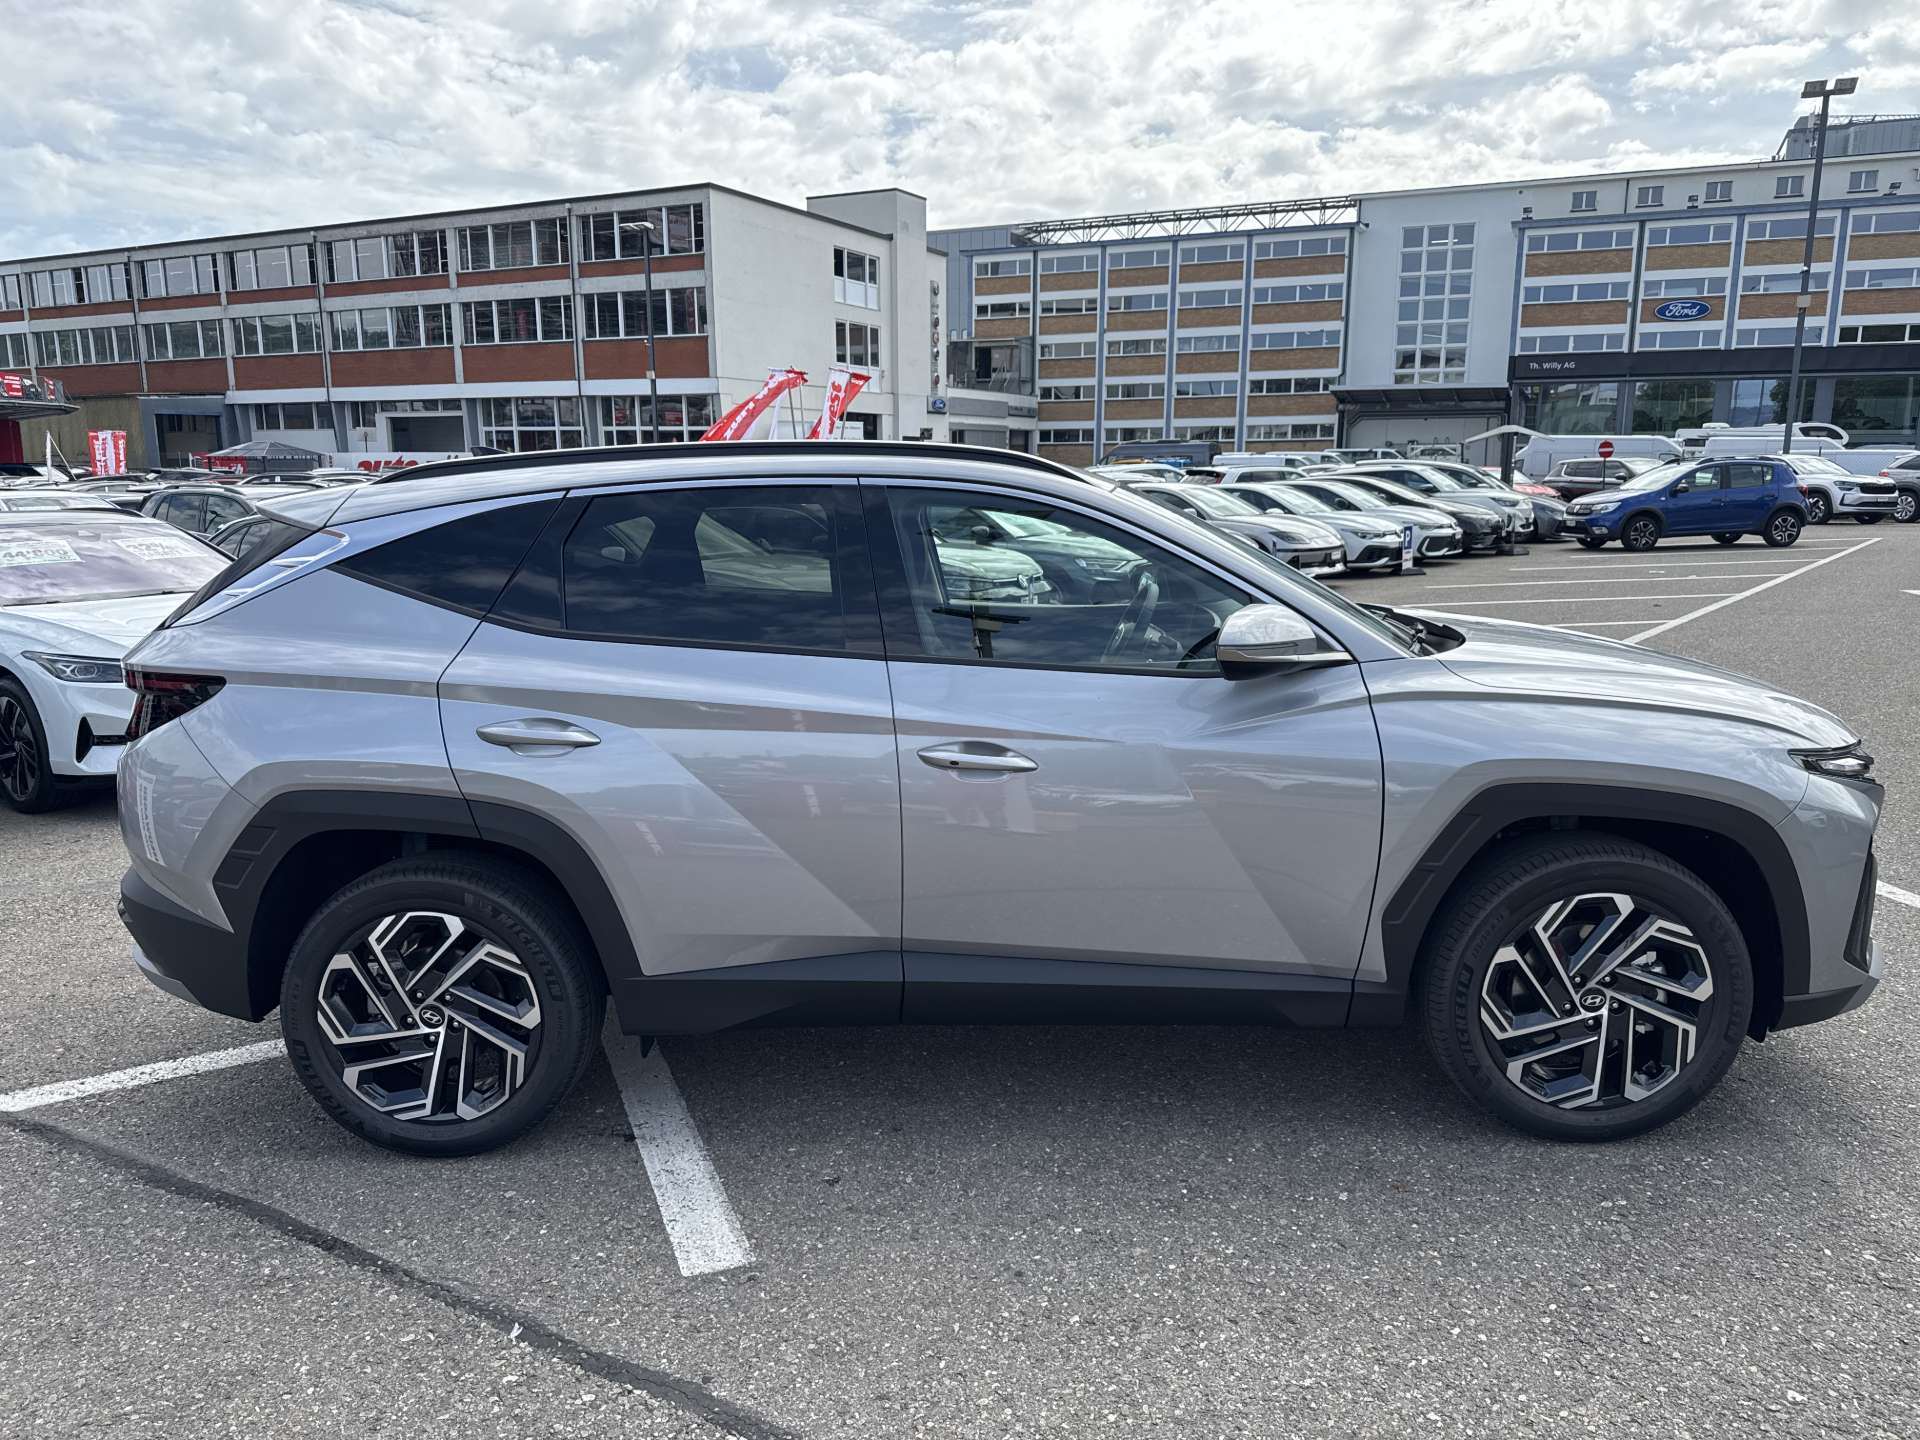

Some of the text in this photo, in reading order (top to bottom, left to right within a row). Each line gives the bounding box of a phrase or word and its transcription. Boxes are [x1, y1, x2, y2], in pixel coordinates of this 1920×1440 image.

[1665, 303, 1701, 317] Ford
[1542, 362, 1561, 370] Willy
[1563, 361, 1576, 369] AG
[494, 910, 563, 998] MICHELIN
[1455, 967, 1479, 1069] MICHELIN
